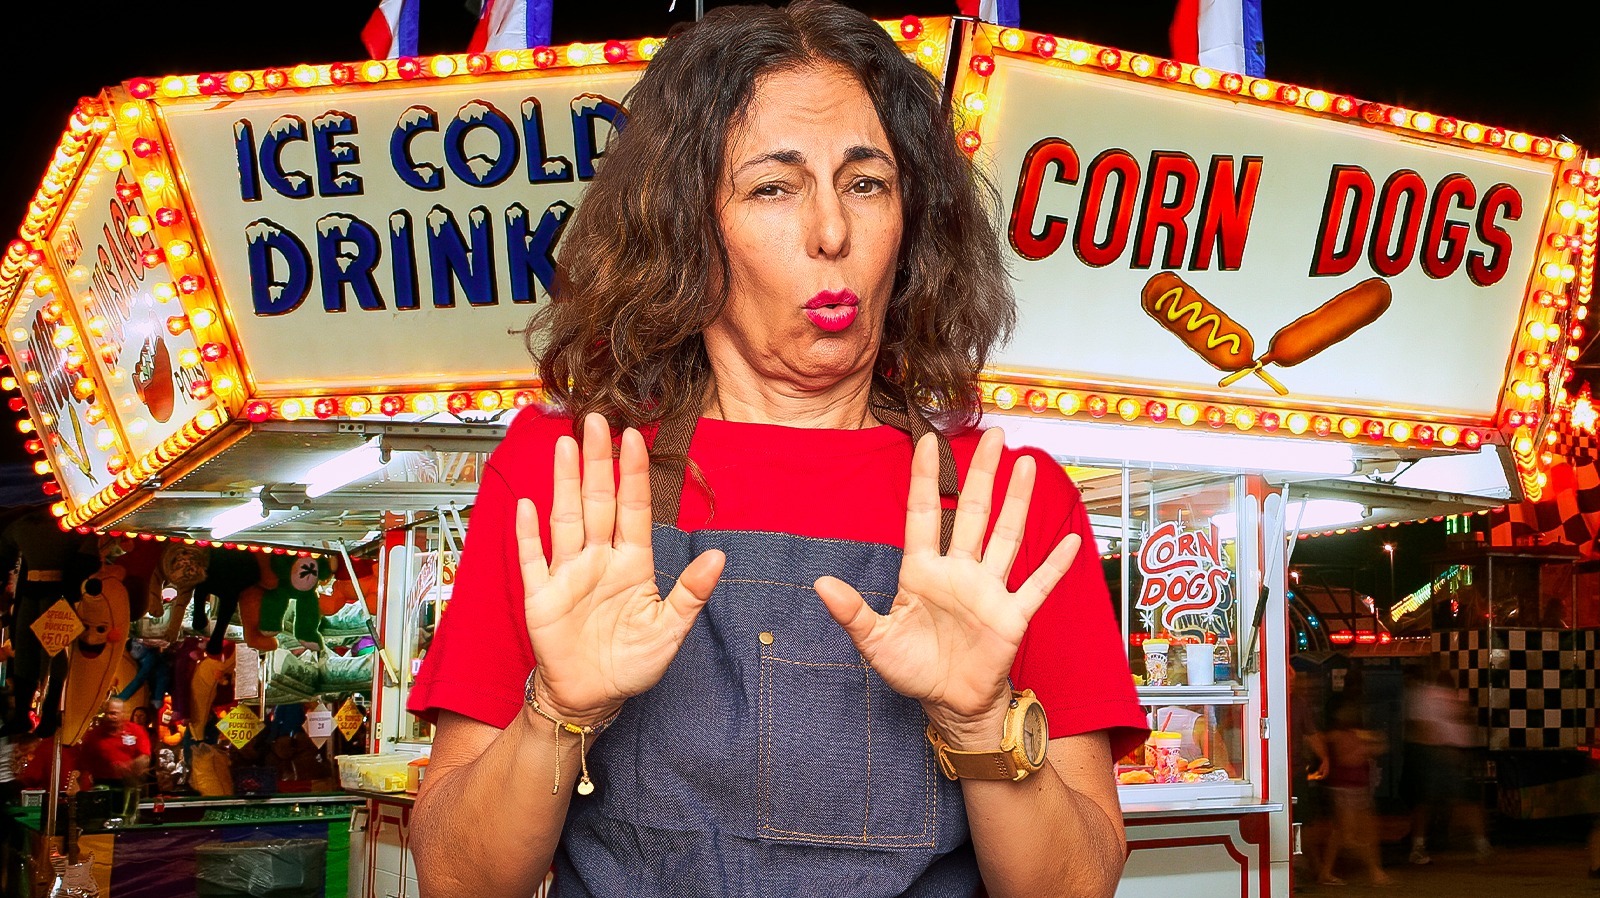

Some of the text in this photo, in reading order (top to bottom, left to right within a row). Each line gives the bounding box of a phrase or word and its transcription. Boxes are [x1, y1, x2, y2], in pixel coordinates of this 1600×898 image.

[233, 93, 630, 201] ICE COLD
[1008, 137, 1522, 287] CORN DOGS
[245, 200, 576, 316] DRINK
[1140, 522, 1221, 574] CORN
[44, 622, 74, 632] BUCKETS
[1139, 568, 1229, 627] DOGS
[229, 721, 256, 729] BUCKETS
